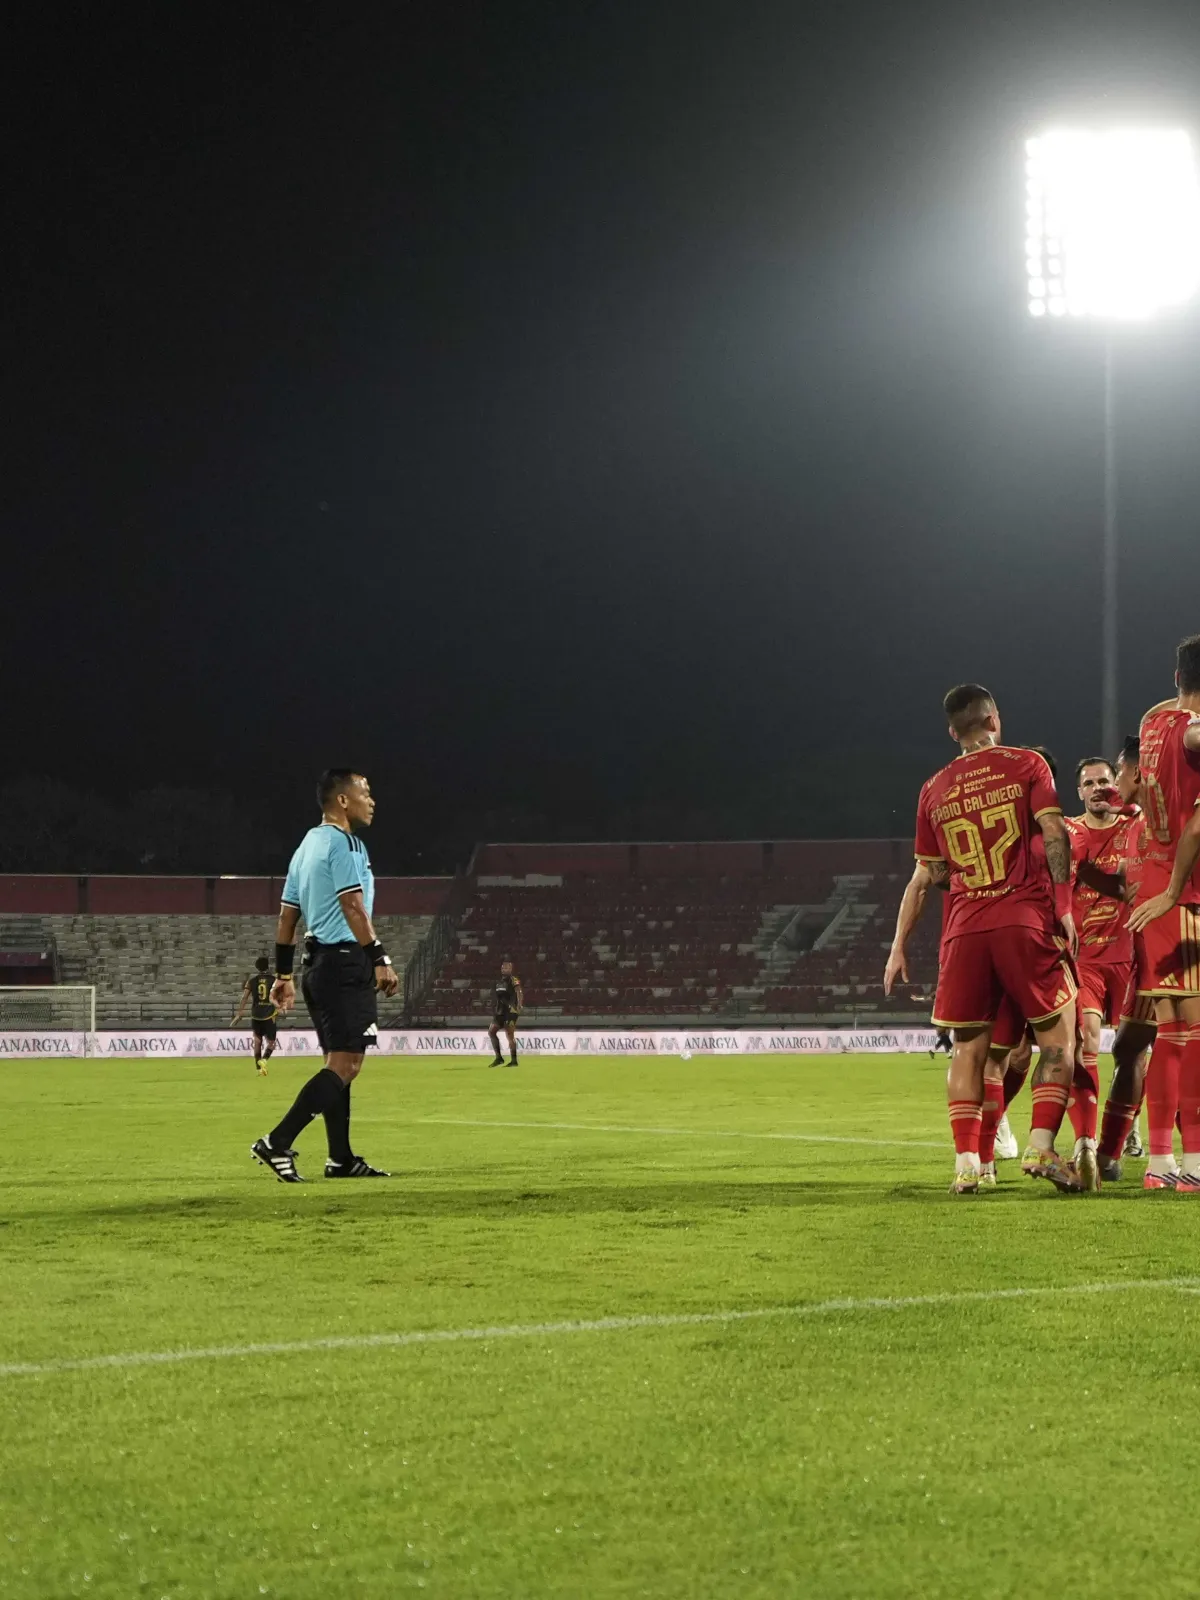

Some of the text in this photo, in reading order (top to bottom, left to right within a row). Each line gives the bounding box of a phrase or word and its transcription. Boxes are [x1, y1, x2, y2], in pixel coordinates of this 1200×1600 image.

[964, 766, 991, 780] PSTORE
[964, 784, 986, 795] BALL
[931, 783, 1023, 823] FÁBIO CALONEGO
[942, 802, 1021, 889] 97
[257, 983, 267, 1000] 9
[0, 1038, 71, 1052] ANARGYA
[108, 1038, 177, 1052] ANARGYA
[416, 1036, 477, 1050] ANARGYA
[515, 1037, 566, 1050] NARGYA
[599, 1037, 656, 1050] ANARGYA
[684, 1036, 739, 1049] ANARGYA
[769, 1036, 822, 1049] ANARGYA
[848, 1035, 899, 1048] ANARGYA
